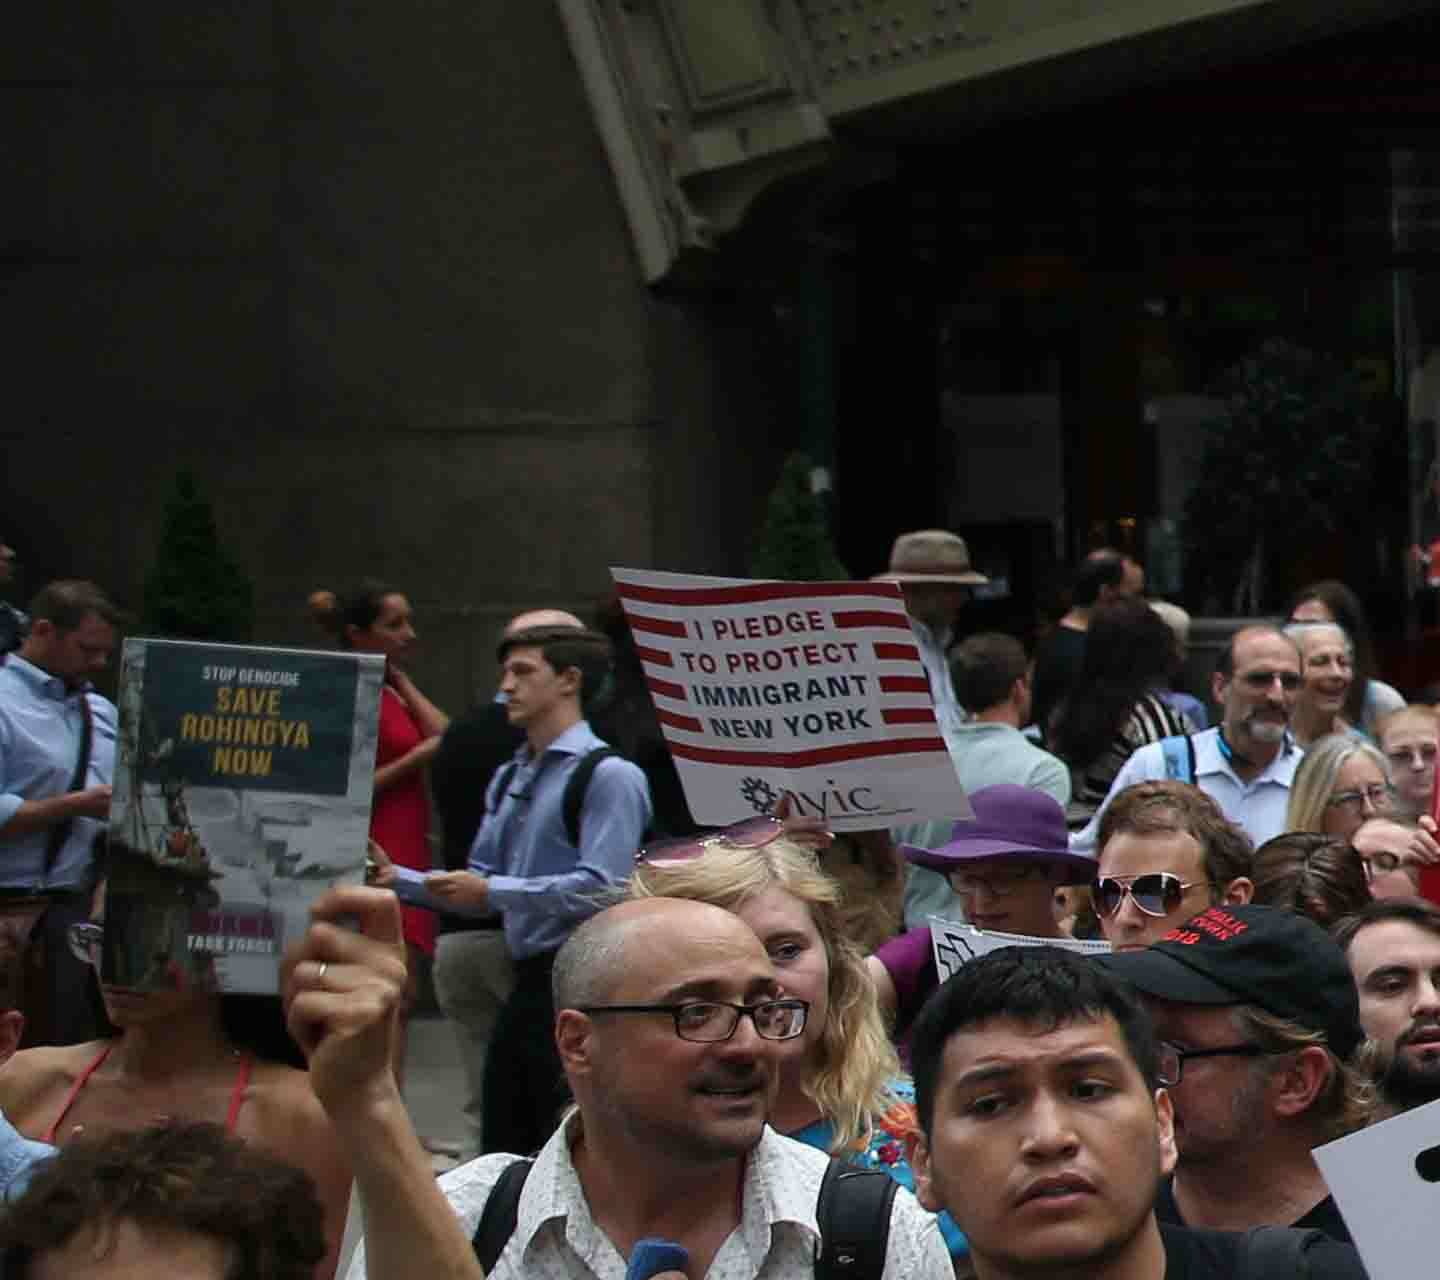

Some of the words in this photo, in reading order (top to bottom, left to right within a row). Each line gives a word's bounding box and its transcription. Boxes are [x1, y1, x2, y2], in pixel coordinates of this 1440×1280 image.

[695, 621, 704, 640] I
[712, 611, 825, 640] PLEDGE
[680, 652, 717, 674] TO
[727, 642, 859, 673] PROTECT
[203, 665, 236, 681] STOP
[239, 668, 300, 687] GENOCIDE
[691, 675, 867, 707] IMMIGRANT
[216, 687, 281, 716] SAVE
[180, 713, 311, 749] ROHINGYA
[710, 717, 774, 739] NEW
[783, 708, 872, 737] YORK
[211, 747, 272, 777] NOW
